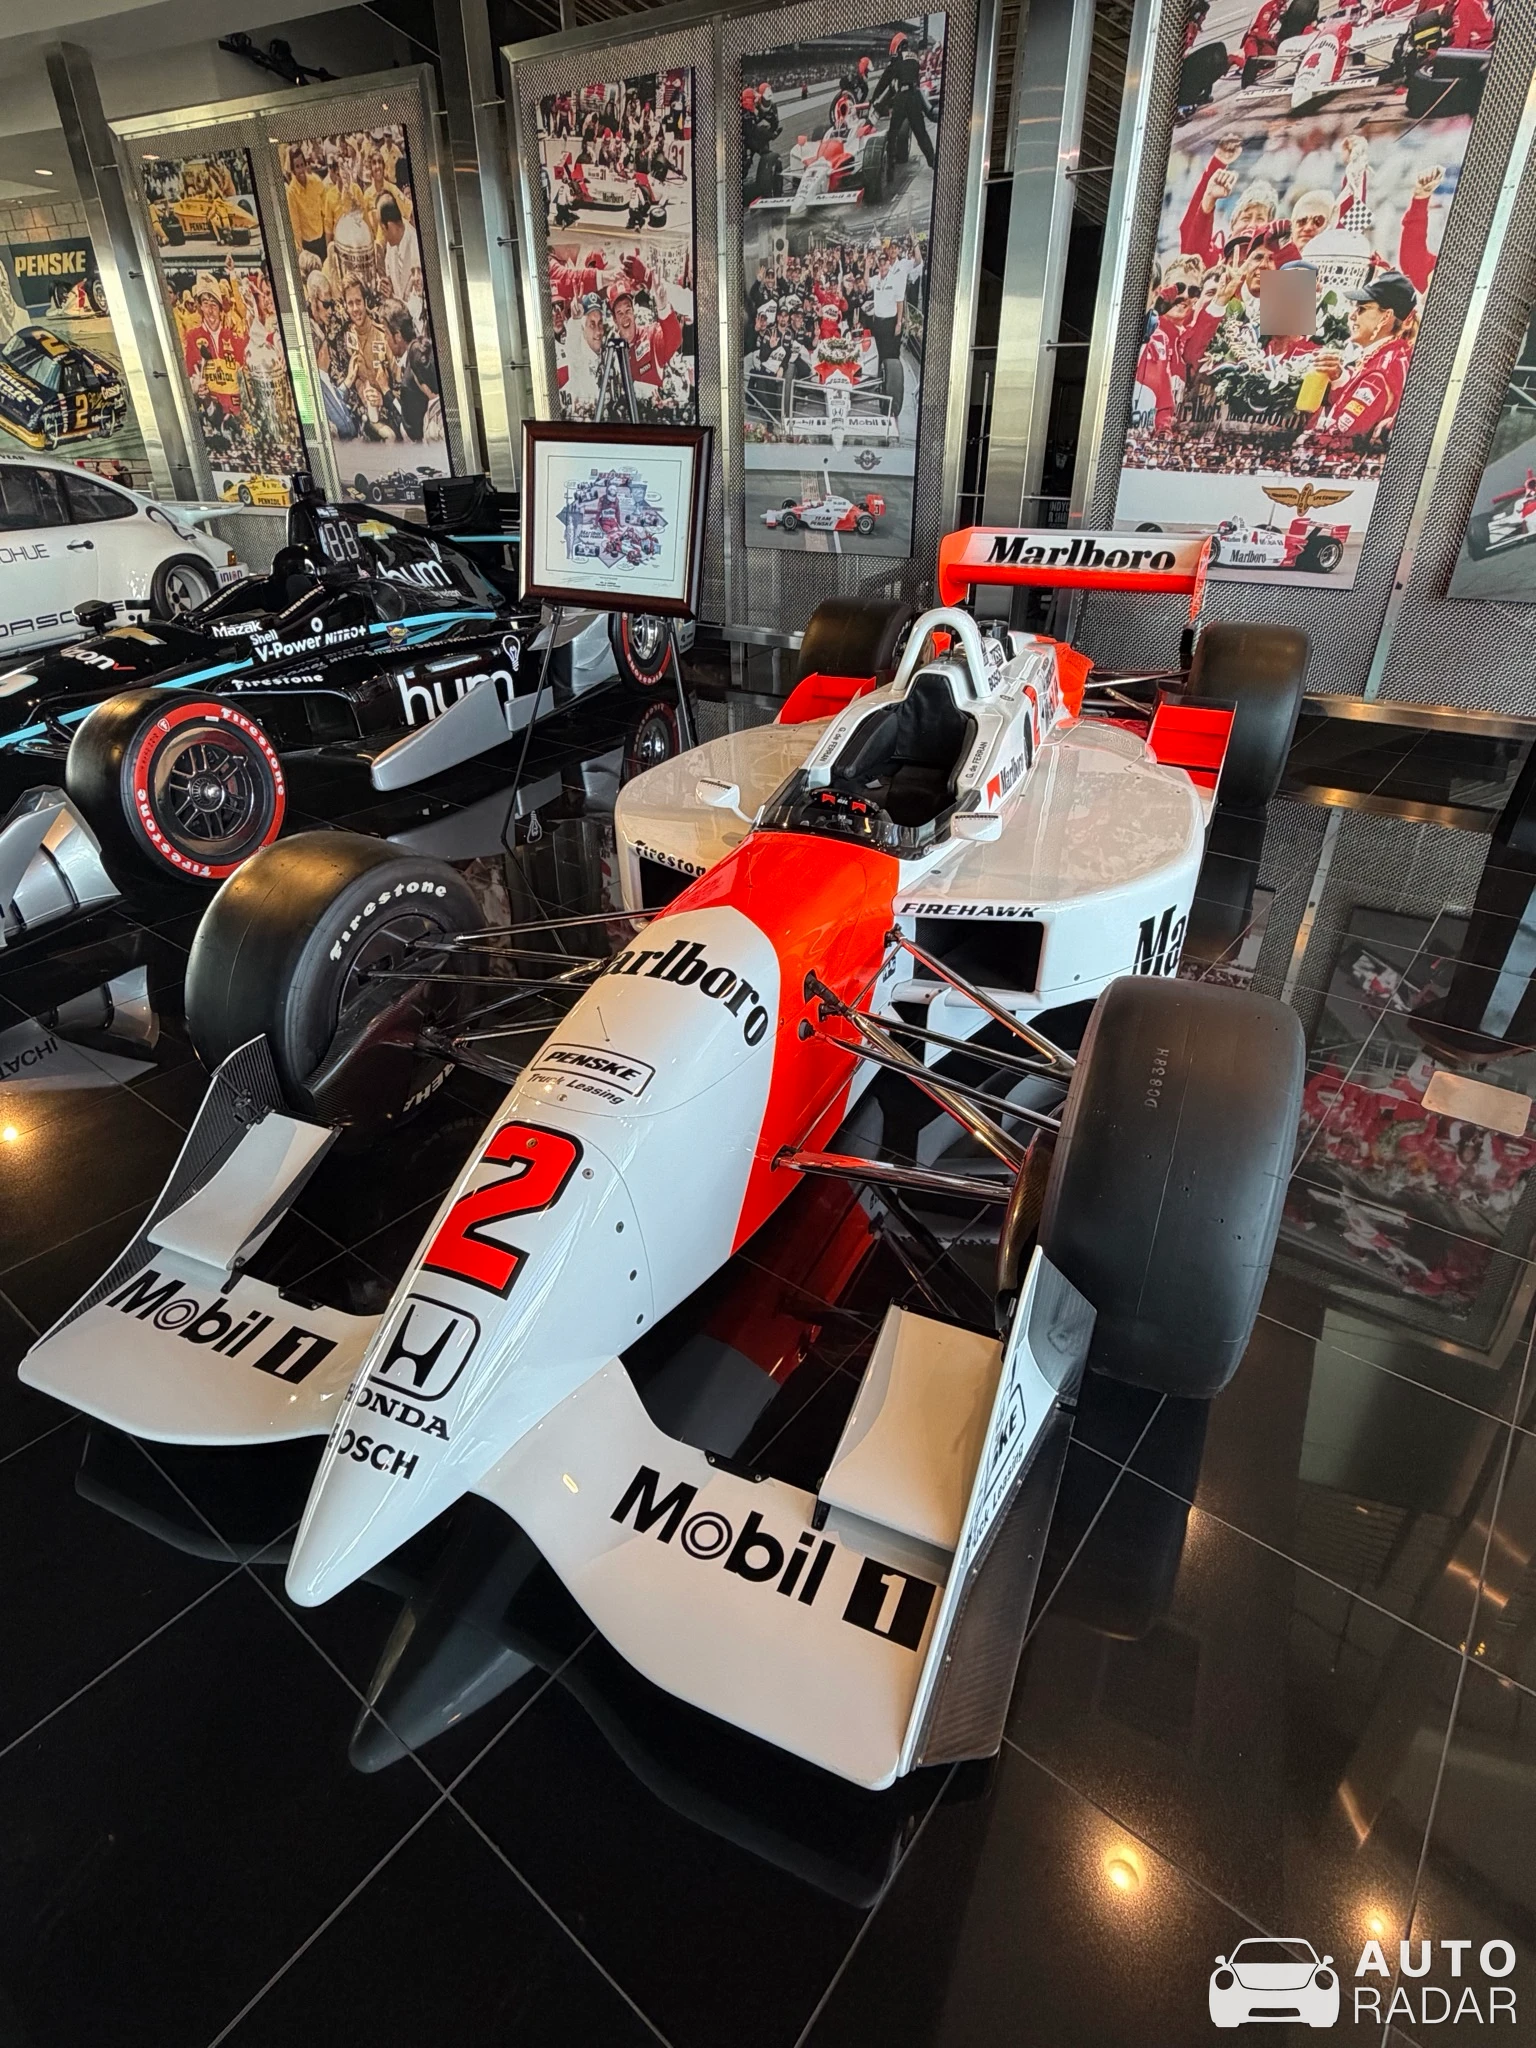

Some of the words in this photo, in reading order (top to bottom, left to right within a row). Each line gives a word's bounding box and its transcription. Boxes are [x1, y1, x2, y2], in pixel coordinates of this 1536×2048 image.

[15, 251, 86, 277] PENSKE
[32, 331, 70, 357] 2
[75, 394, 88, 429] 2
[984, 535, 1176, 571] Marlboro
[1251, 531, 1259, 546] 4
[1229, 549, 1267, 564] Marlboro
[212, 622, 263, 638] Mazak
[250, 629, 279, 646] Shell
[255, 635, 321, 663] V-Power
[231, 674, 324, 691] Firestone
[220, 707, 286, 796] Firestone
[818, 740, 839, 763] FERRAN
[972, 741, 989, 765] FERRAN
[137, 788, 212, 878] Firestone
[634, 840, 707, 878] Fireston
[329, 881, 447, 961] Firestone
[900, 902, 1041, 918] FIREHAWK
[1132, 904, 1188, 976] Ma
[600, 939, 769, 1047] arlboro
[543, 1050, 642, 1081] PENSKE
[403, 1062, 456, 1113] REHA
[527, 1073, 566, 1086] Truck
[566, 1079, 626, 1105] Leasing
[422, 1121, 585, 1300] 2
[107, 1270, 276, 1357] Mobil
[609, 1464, 836, 1607] Mobil
